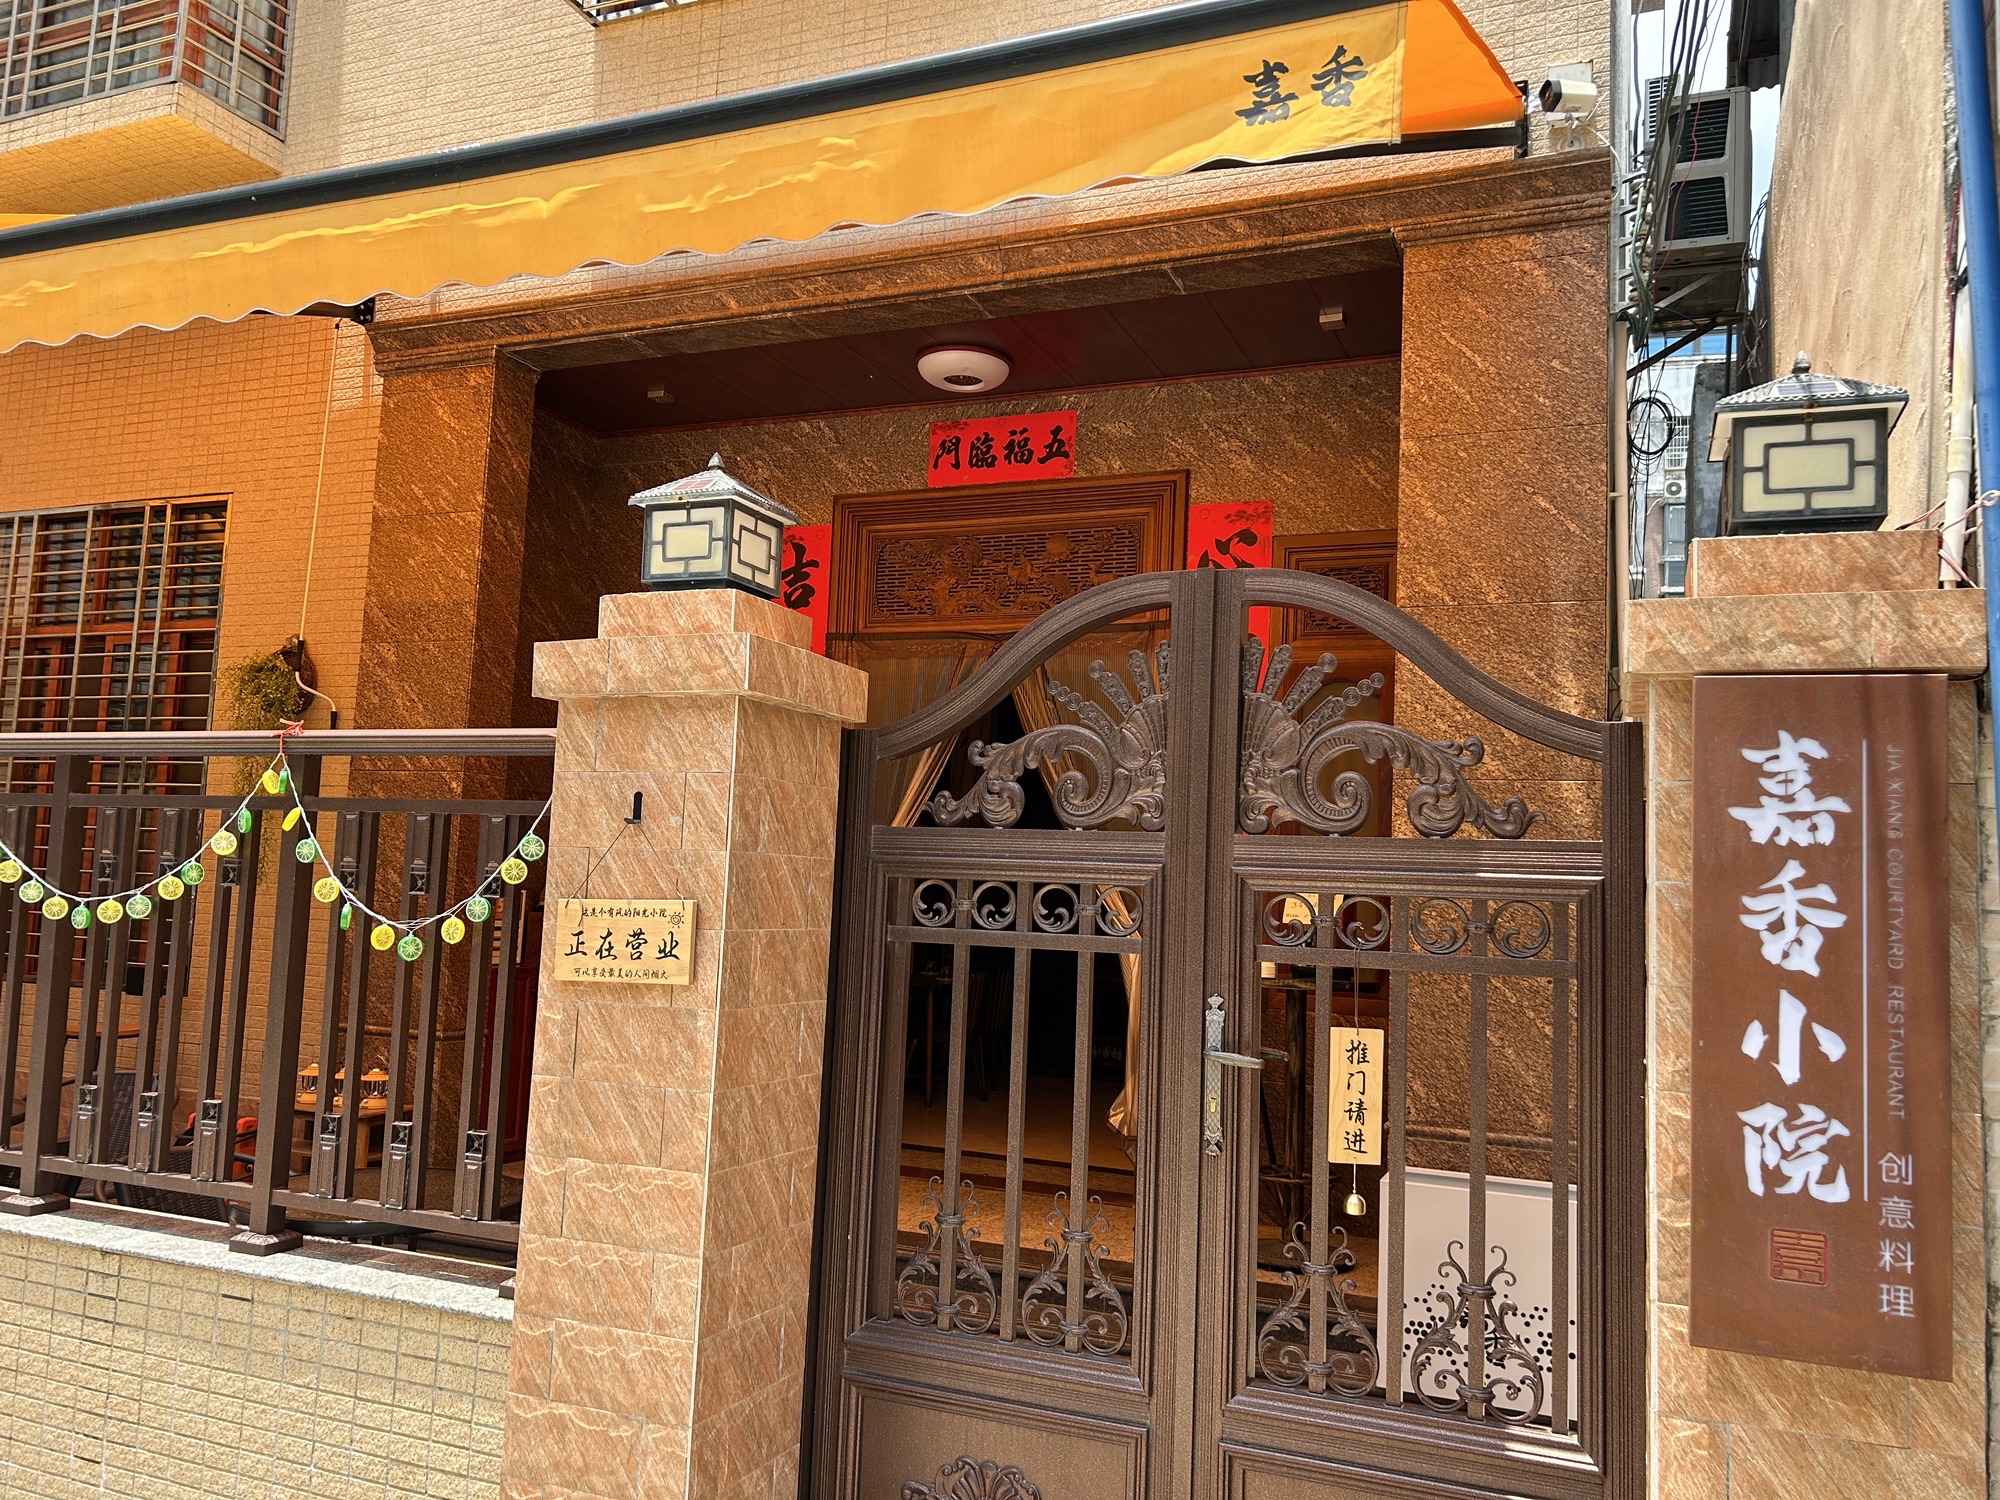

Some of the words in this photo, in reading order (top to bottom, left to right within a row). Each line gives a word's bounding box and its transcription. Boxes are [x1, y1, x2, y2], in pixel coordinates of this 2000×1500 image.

[1234, 44, 1369, 127] 嘉香
[1886, 744, 1904, 772] JIA
[1886, 780, 1905, 839] XIANG
[564, 927, 681, 961] 正在营业
[1727, 729, 1852, 1203] 嘉香小院
[1886, 848, 1905, 970] COURTYARD
[1342, 1039, 1370, 1154] 推门请进
[1887, 985, 1906, 1121] RESTAURANT
[1877, 1151, 1916, 1318] 创意料理
